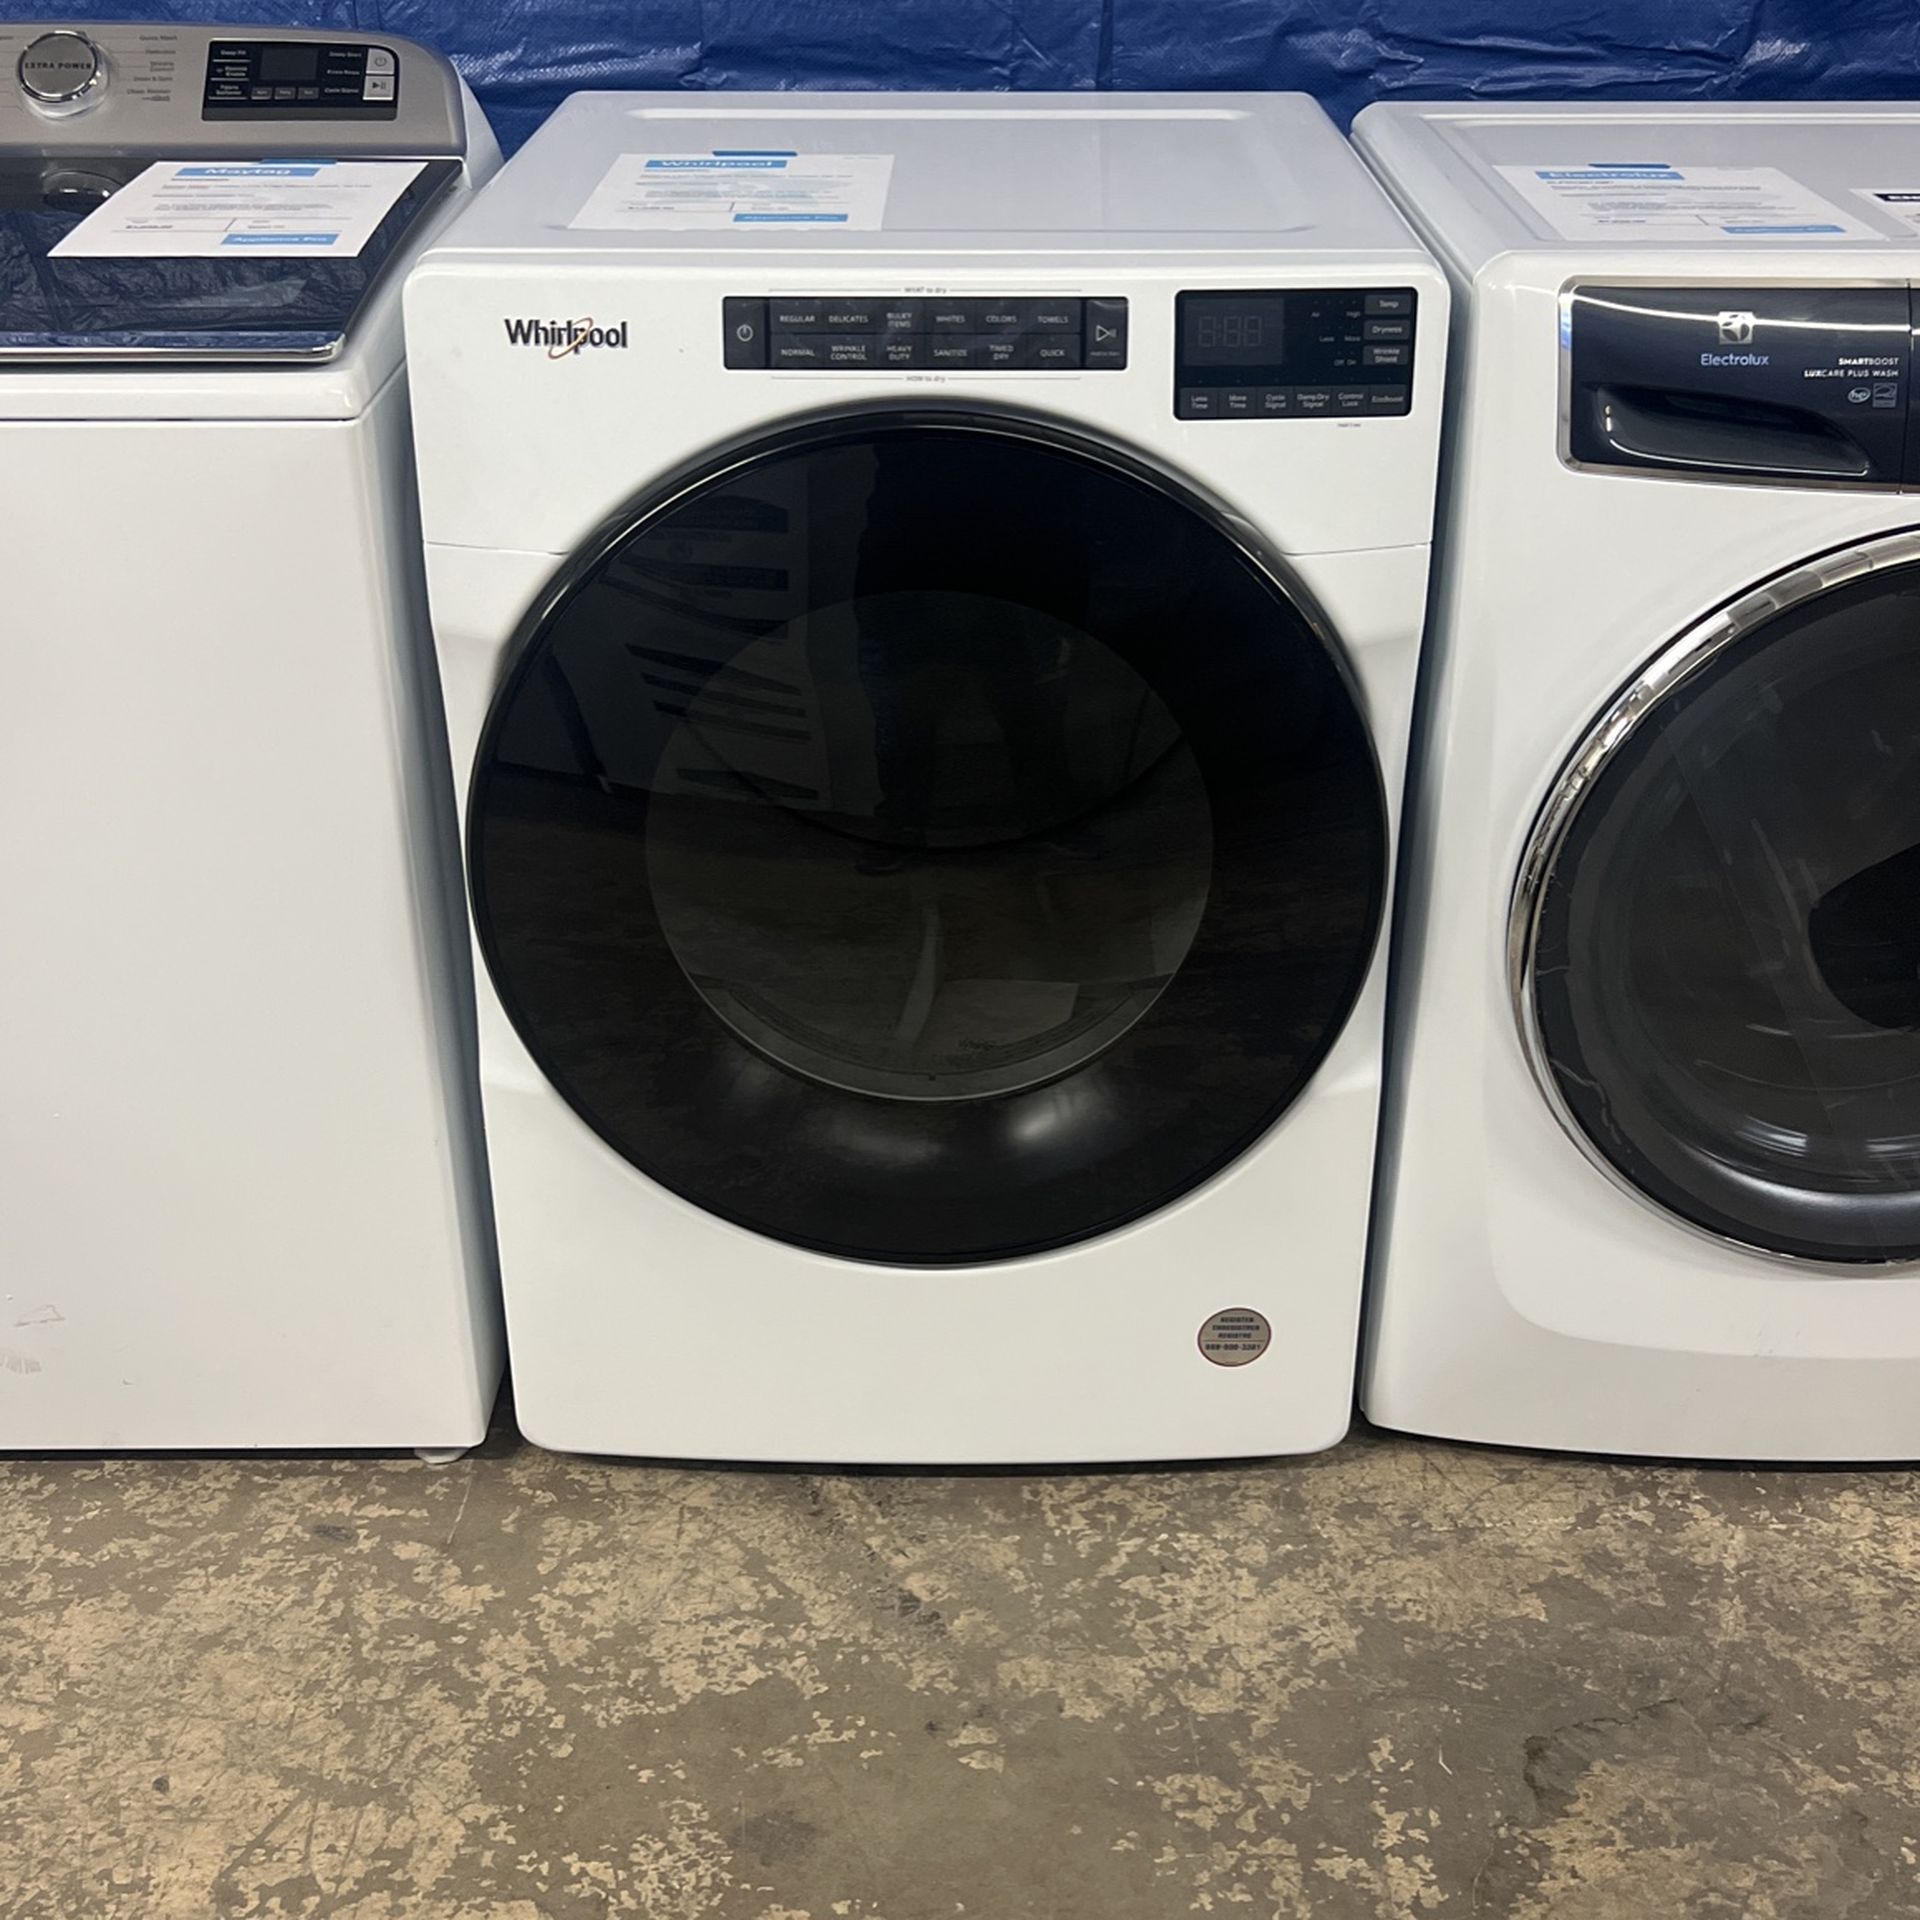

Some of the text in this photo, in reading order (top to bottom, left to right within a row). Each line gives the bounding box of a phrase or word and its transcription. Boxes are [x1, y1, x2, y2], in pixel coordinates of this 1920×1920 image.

[661, 160, 773, 168] Whirlpool
[205, 168, 291, 176] Maytag
[1550, 171, 1671, 179] Electrolux
[1379, 300, 1399, 308] Temp
[936, 315, 965, 323] WHITES
[986, 315, 1017, 323] COLORS
[1037, 315, 1069, 323] TOWELS
[887, 320, 911, 328] ITEMS
[1372, 326, 1402, 335] Dryness
[504, 318, 628, 354] Whirlpool
[933, 349, 968, 357] SANITIZE
[1700, 353, 1769, 366] Electrolux
[1838, 357, 1899, 366] SMARTBOOST
[1804, 369, 1899, 377] LUXCARE PLUS WASH
[1265, 401, 1286, 409] Signal
[1302, 401, 1324, 409] Signal
